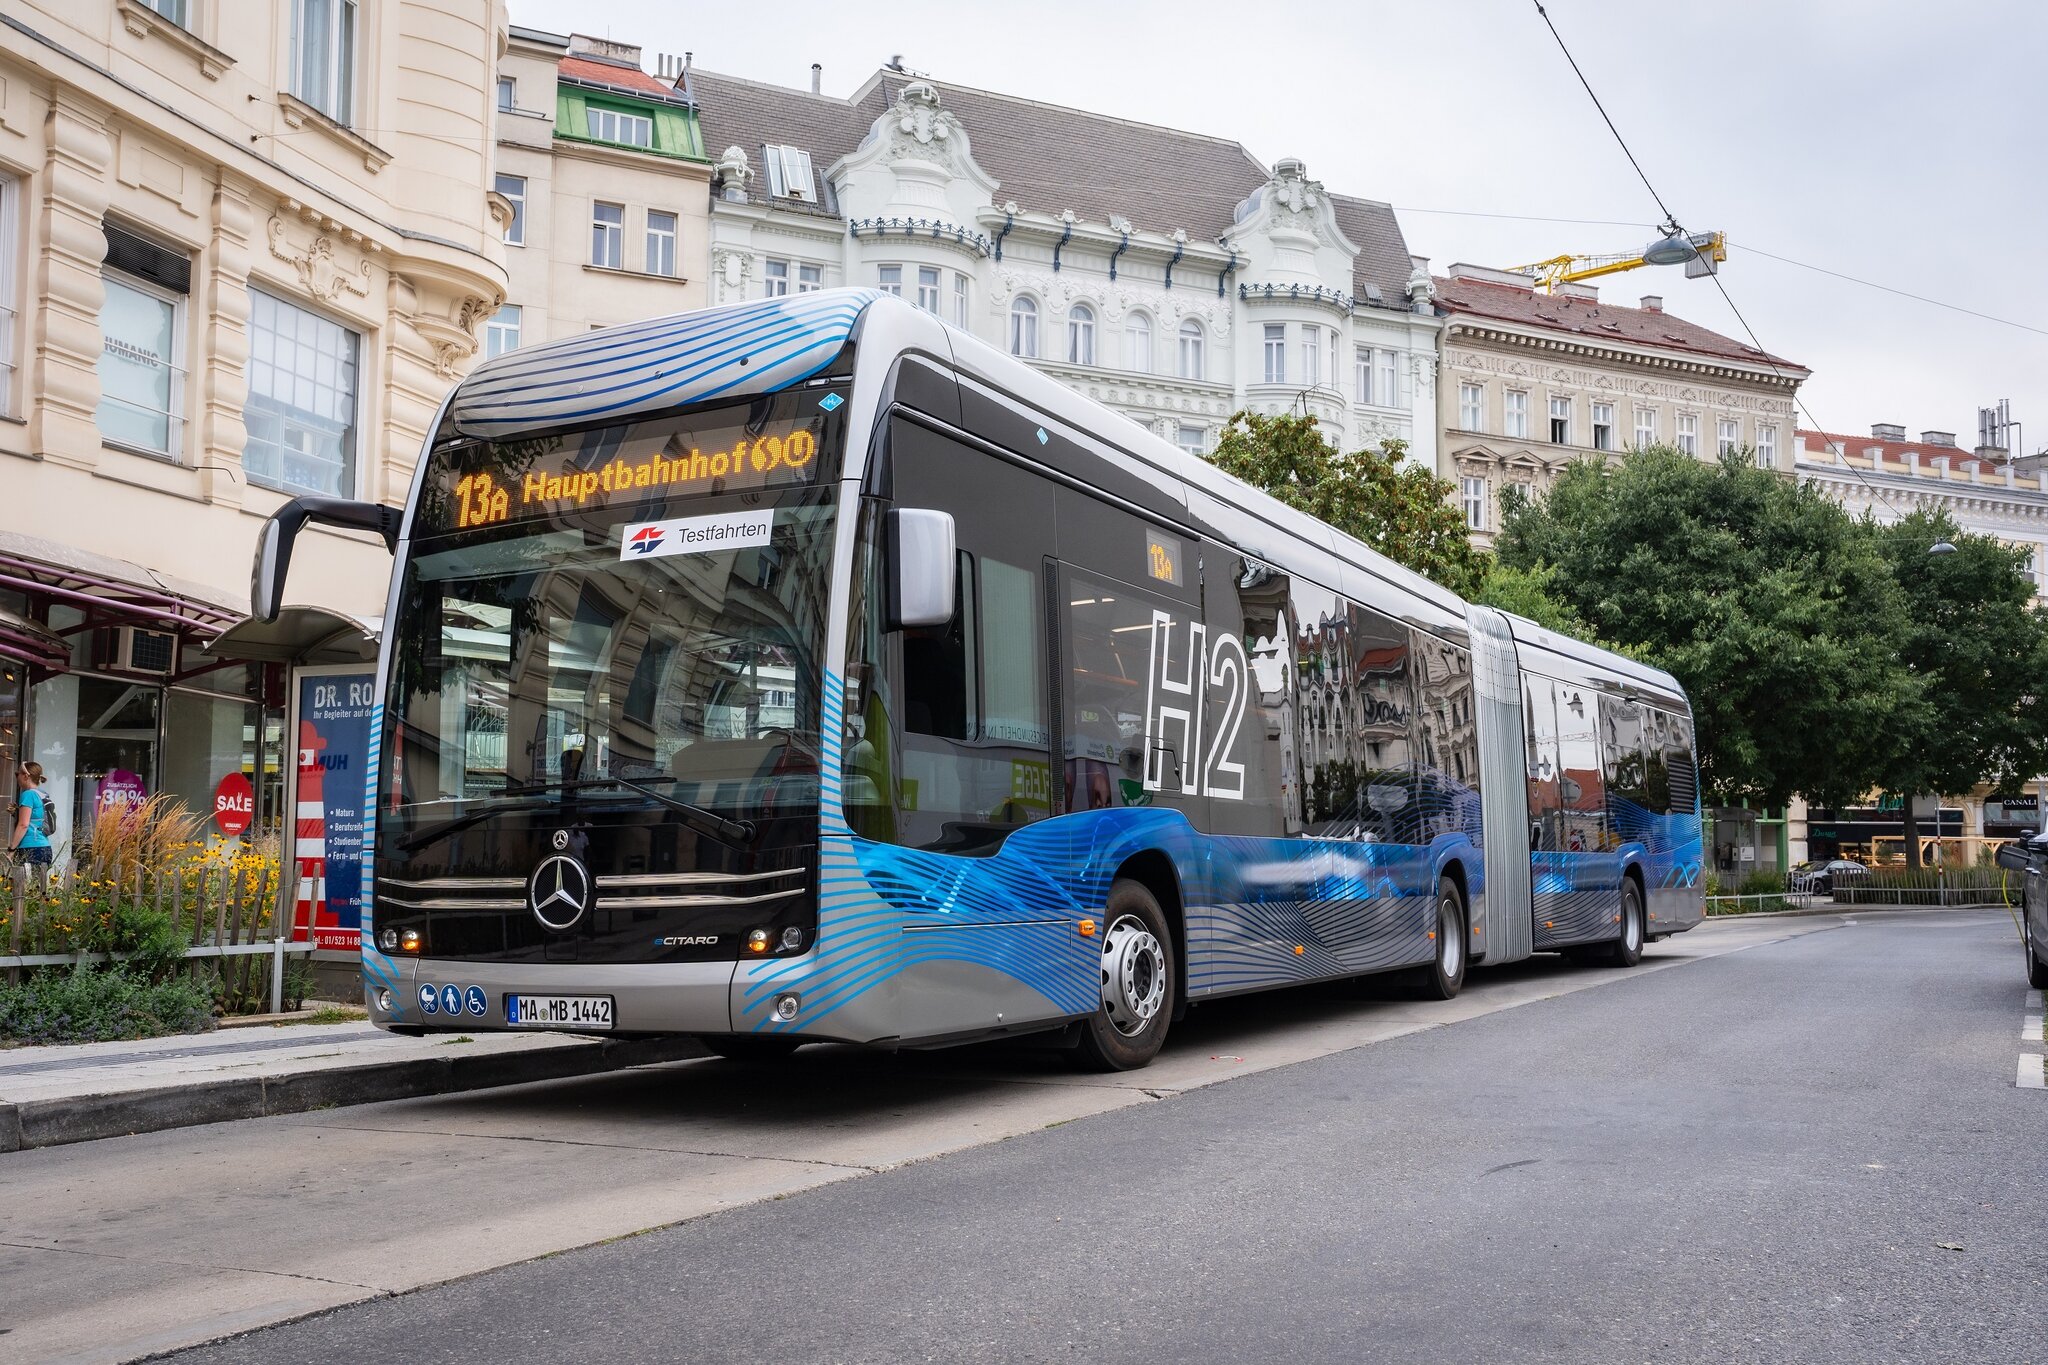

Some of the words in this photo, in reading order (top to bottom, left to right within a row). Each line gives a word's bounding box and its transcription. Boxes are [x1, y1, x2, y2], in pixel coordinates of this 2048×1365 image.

[456, 473, 509, 527] 13A
[523, 441, 747, 503] Hauptbahnhof
[678, 523, 767, 544] Testfahrten
[315, 685, 342, 708] DR.
[1143, 609, 1248, 800] H2
[323, 709, 352, 720] Begleiter
[217, 792, 252, 812] SALE
[335, 809, 355, 817] Matura
[654, 936, 719, 946] eCITARO
[519, 999, 538, 1021] MA
[549, 999, 569, 1021] MB
[572, 1000, 610, 1022] 1442
